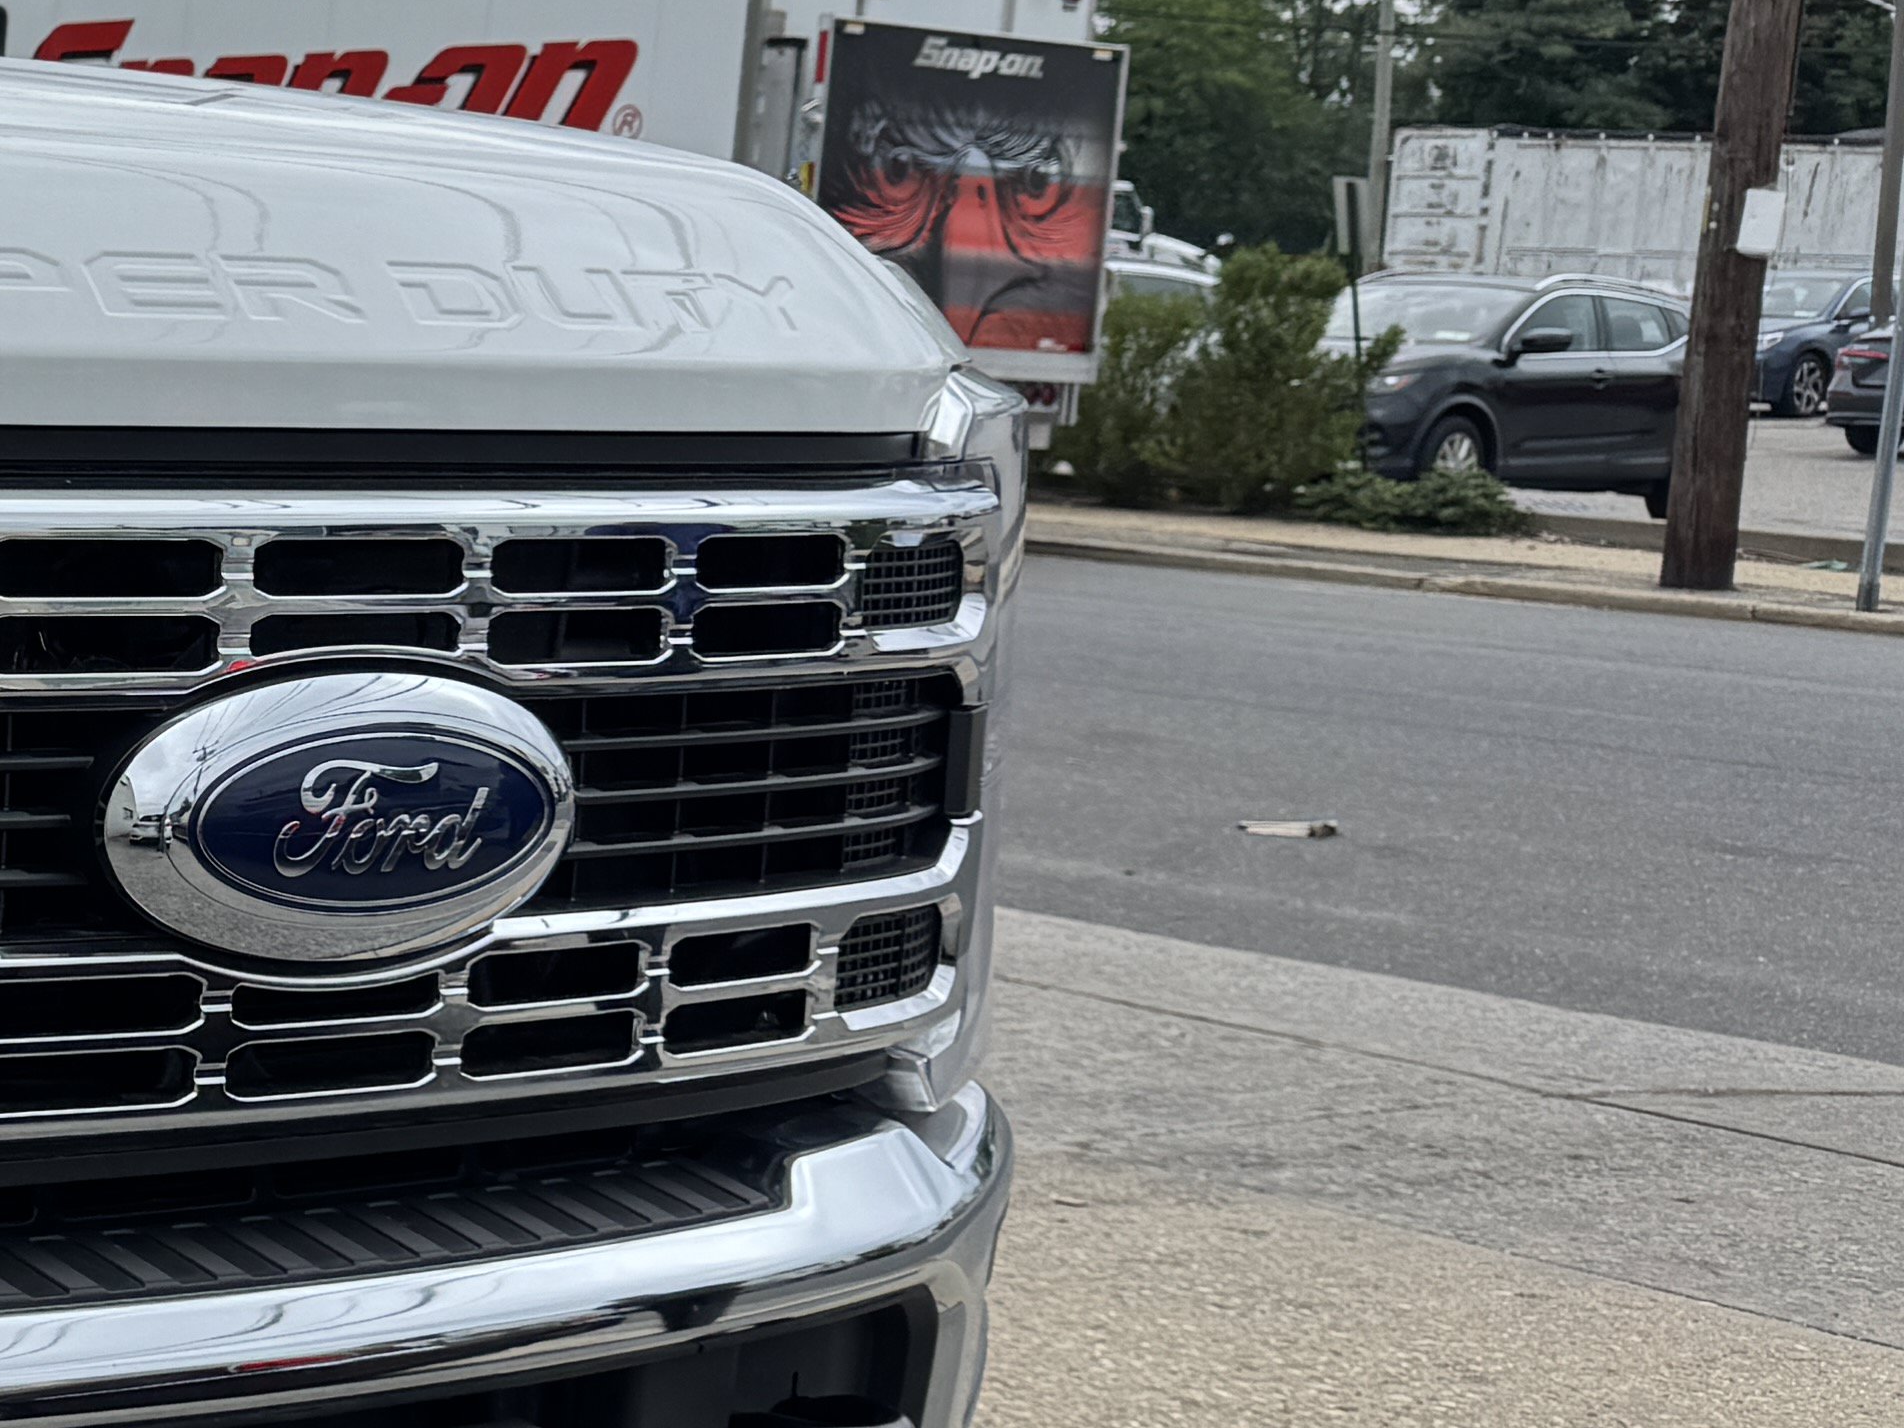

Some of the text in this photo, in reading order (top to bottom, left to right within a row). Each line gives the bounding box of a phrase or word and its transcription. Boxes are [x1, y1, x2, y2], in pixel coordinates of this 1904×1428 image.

[913, 36, 1044, 80] Snap-on
[385, 256, 800, 337] DUTY
[273, 759, 489, 878] Ford
